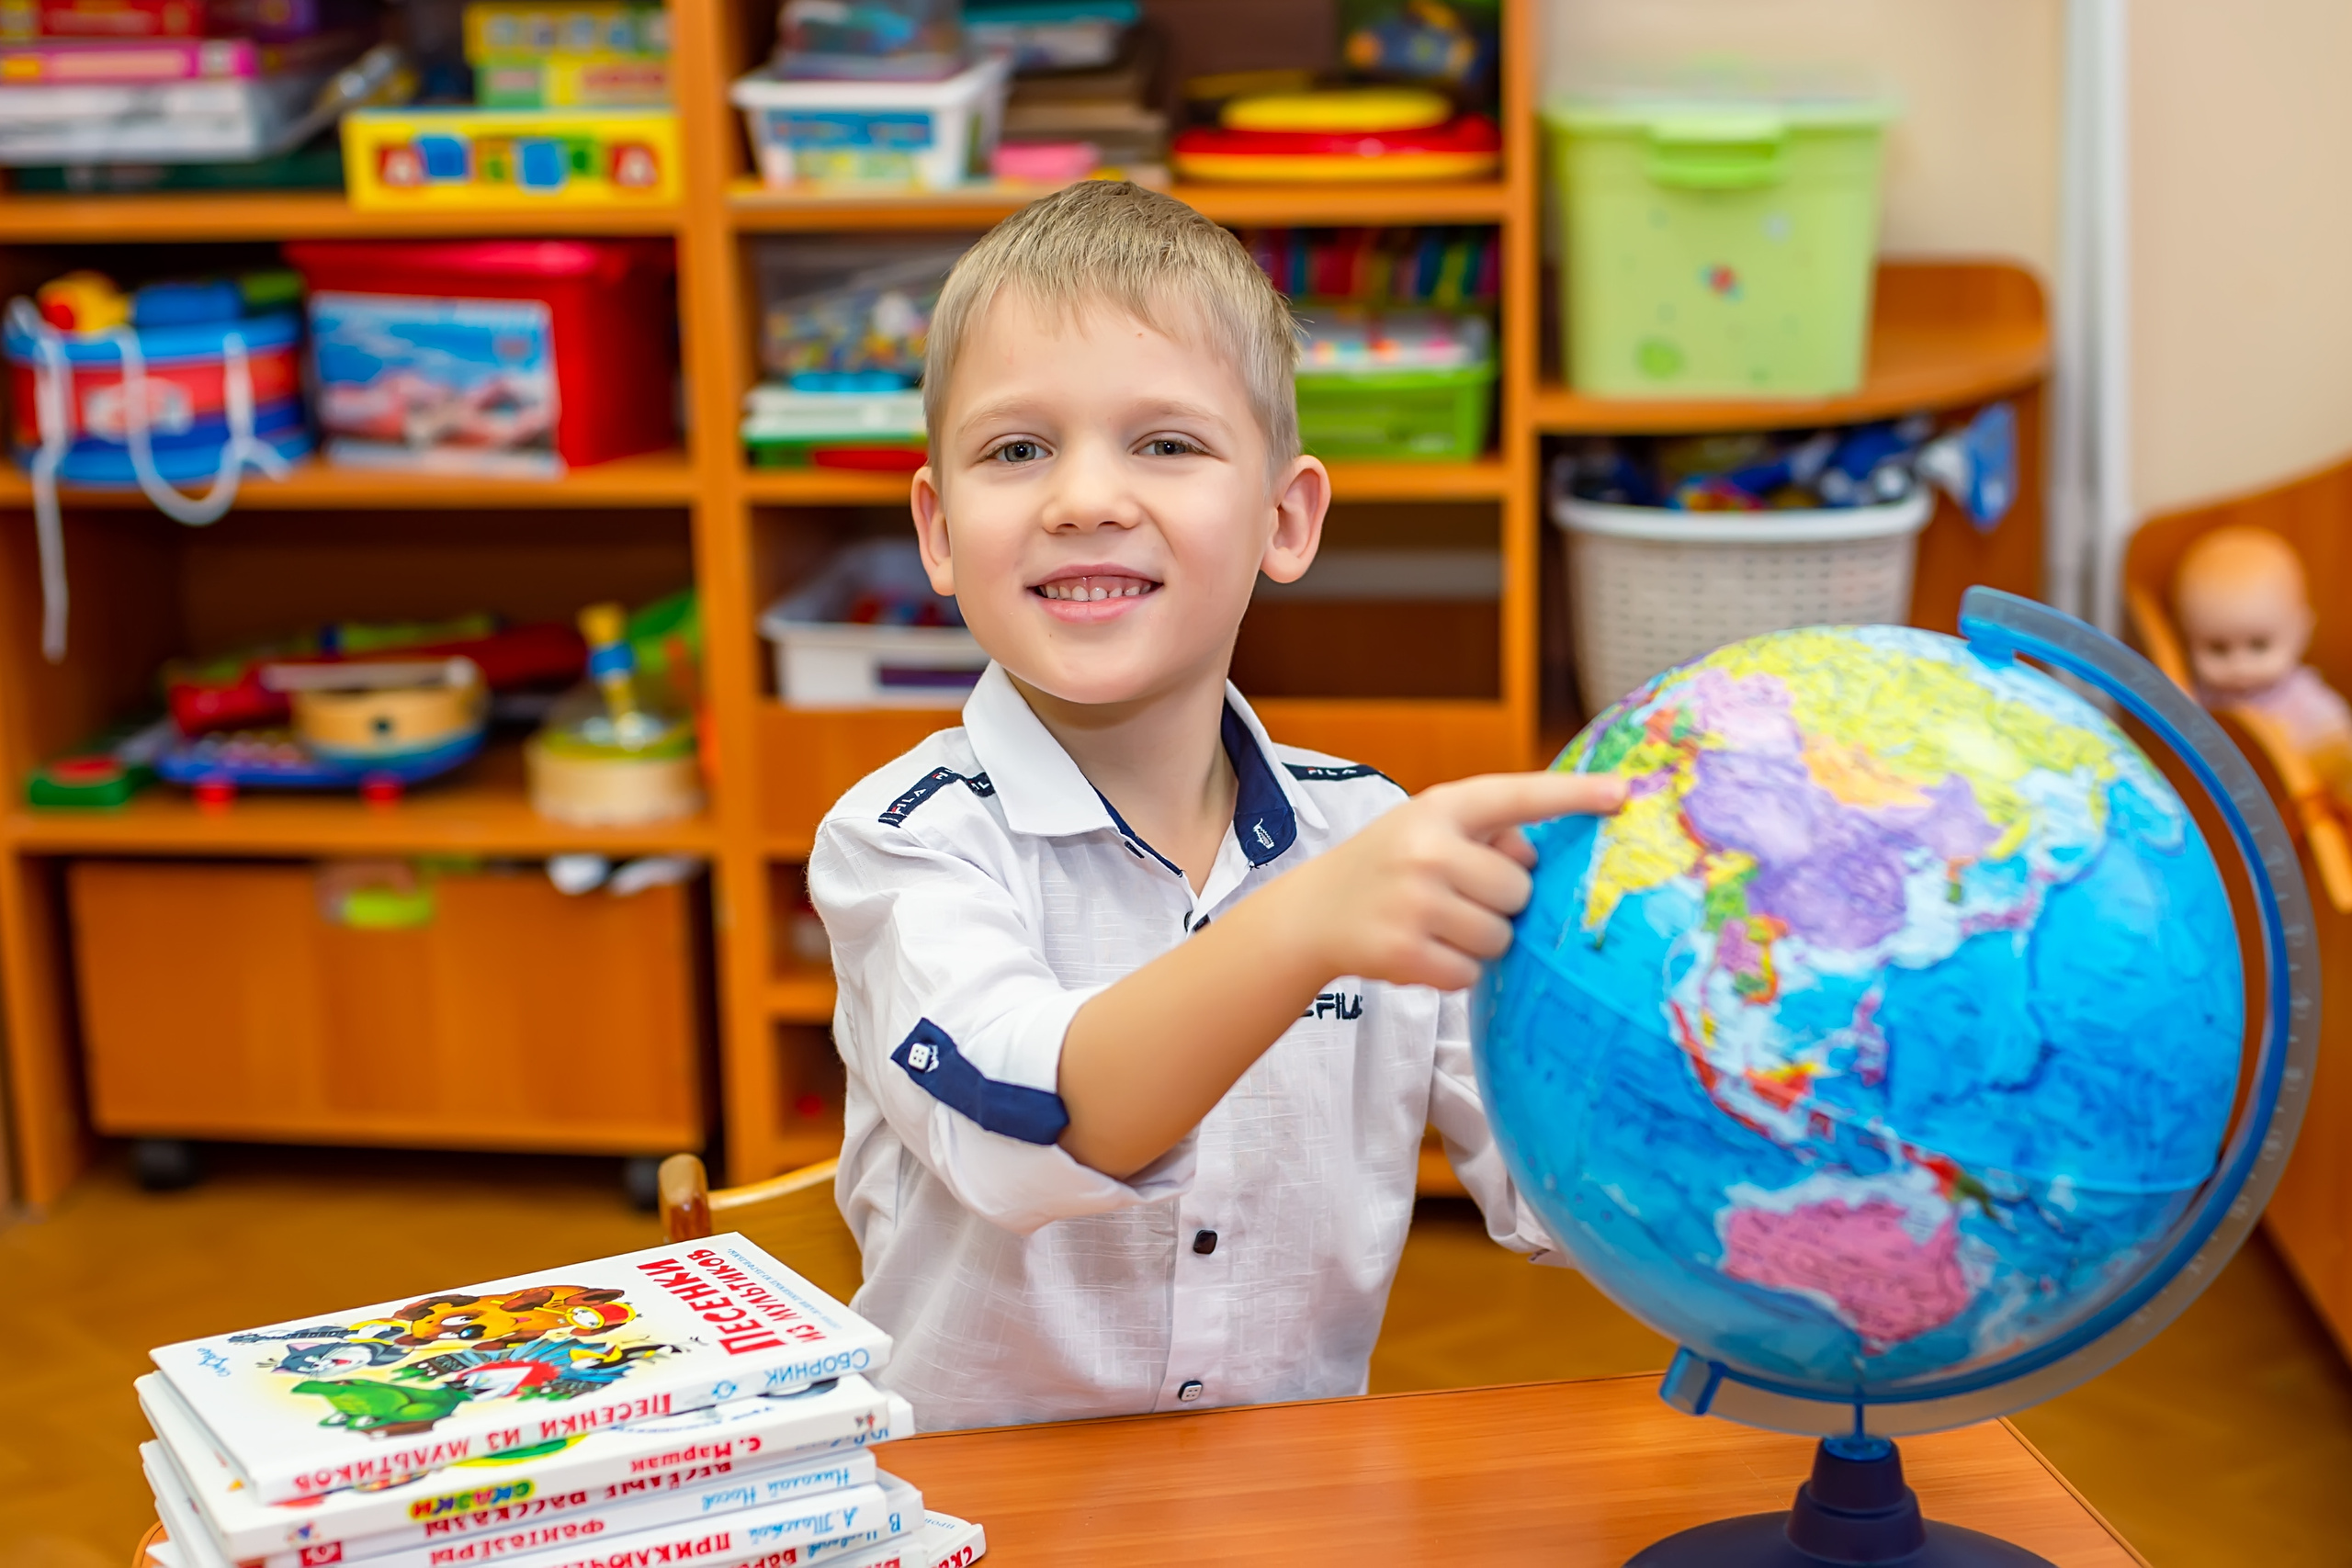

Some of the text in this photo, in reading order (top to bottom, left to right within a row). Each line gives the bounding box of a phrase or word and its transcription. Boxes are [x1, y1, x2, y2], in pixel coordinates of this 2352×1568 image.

[1306, 767, 1357, 776] FILA
[891, 788, 927, 814] FILA
[1315, 991, 1363, 1021] FILA
[636, 1258, 788, 1356] ПЕСЕНКИ
[686, 1248, 827, 1344] ИЗ МУЛЬТИКОВ
[764, 1347, 871, 1387] СБОРНИК
[540, 1393, 672, 1440] ПЕСЕНКИ
[485, 1427, 521, 1451] ИЗ
[630, 1441, 732, 1473] Маршак
[293, 1437, 471, 1491] МУЛЬТИКОВ
[701, 1467, 850, 1512] Николай Носов
